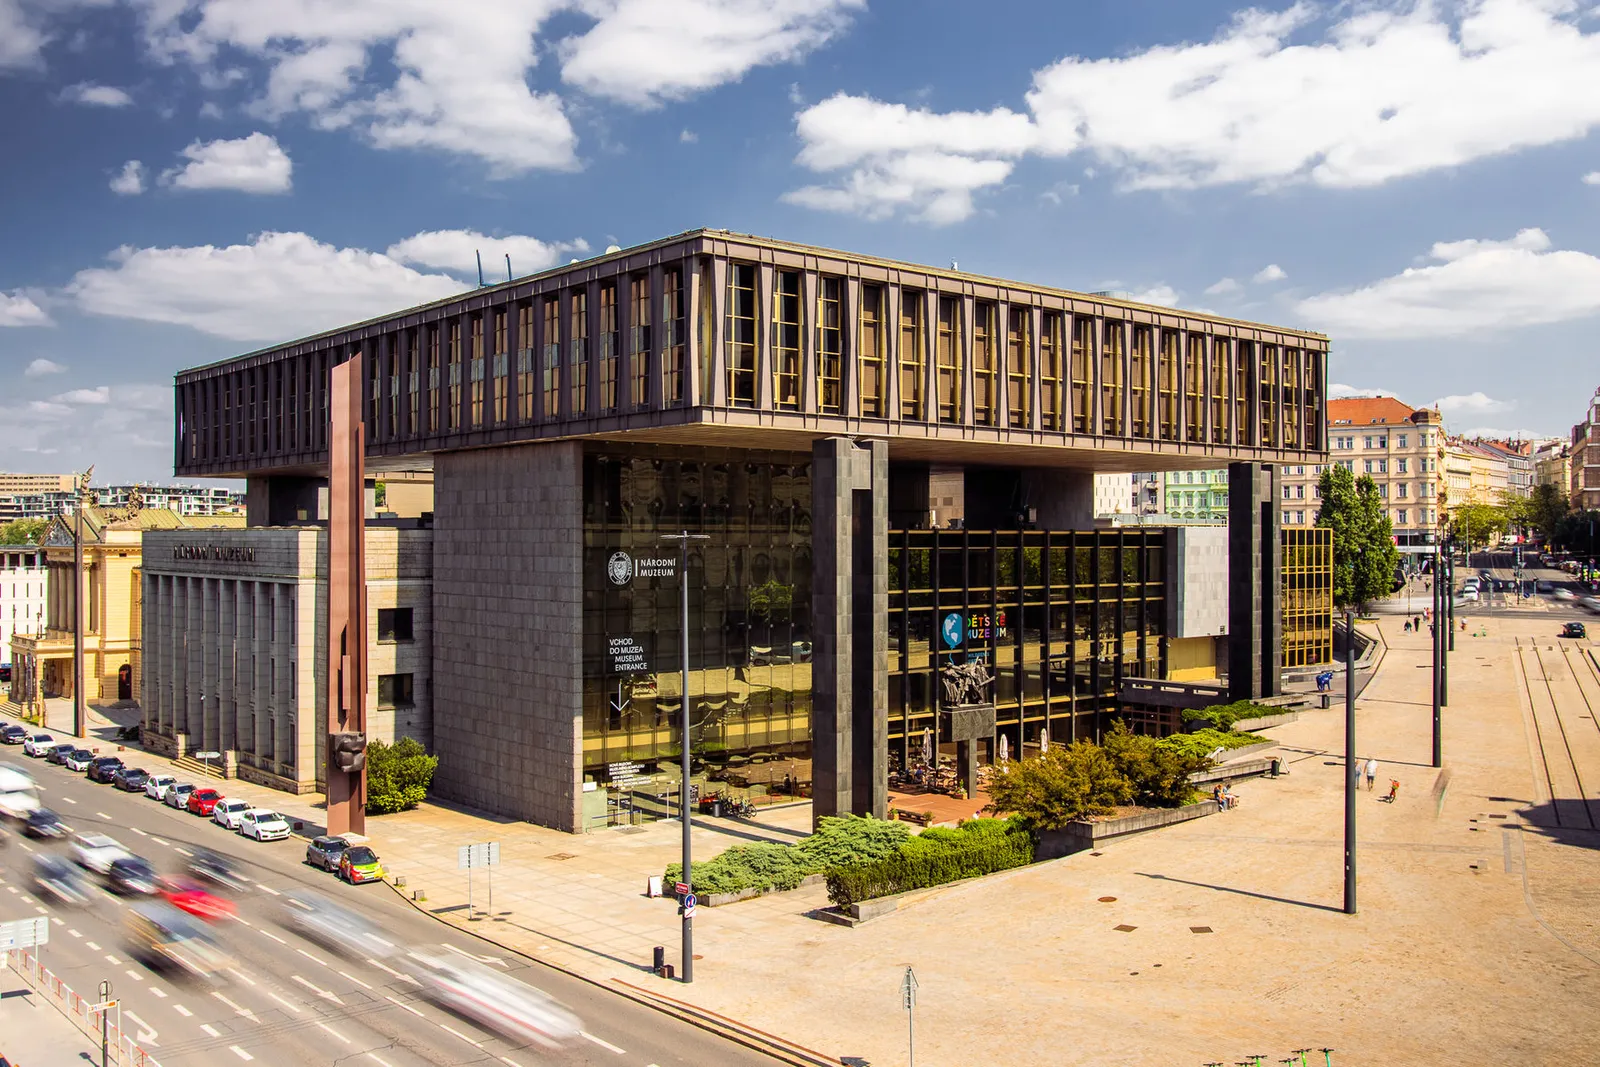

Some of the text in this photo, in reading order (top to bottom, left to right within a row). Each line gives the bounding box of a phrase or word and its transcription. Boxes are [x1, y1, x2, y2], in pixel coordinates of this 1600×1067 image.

[215, 546, 255, 561] MUZEUM
[640, 558, 676, 567] NÁRODNÍ
[640, 569, 674, 577] MUZEUM
[609, 638, 633, 646] VCHOD
[610, 646, 644, 655] DO MUZEA
[615, 655, 643, 663] MUSEUM
[615, 663, 648, 672] ENTRANCE
